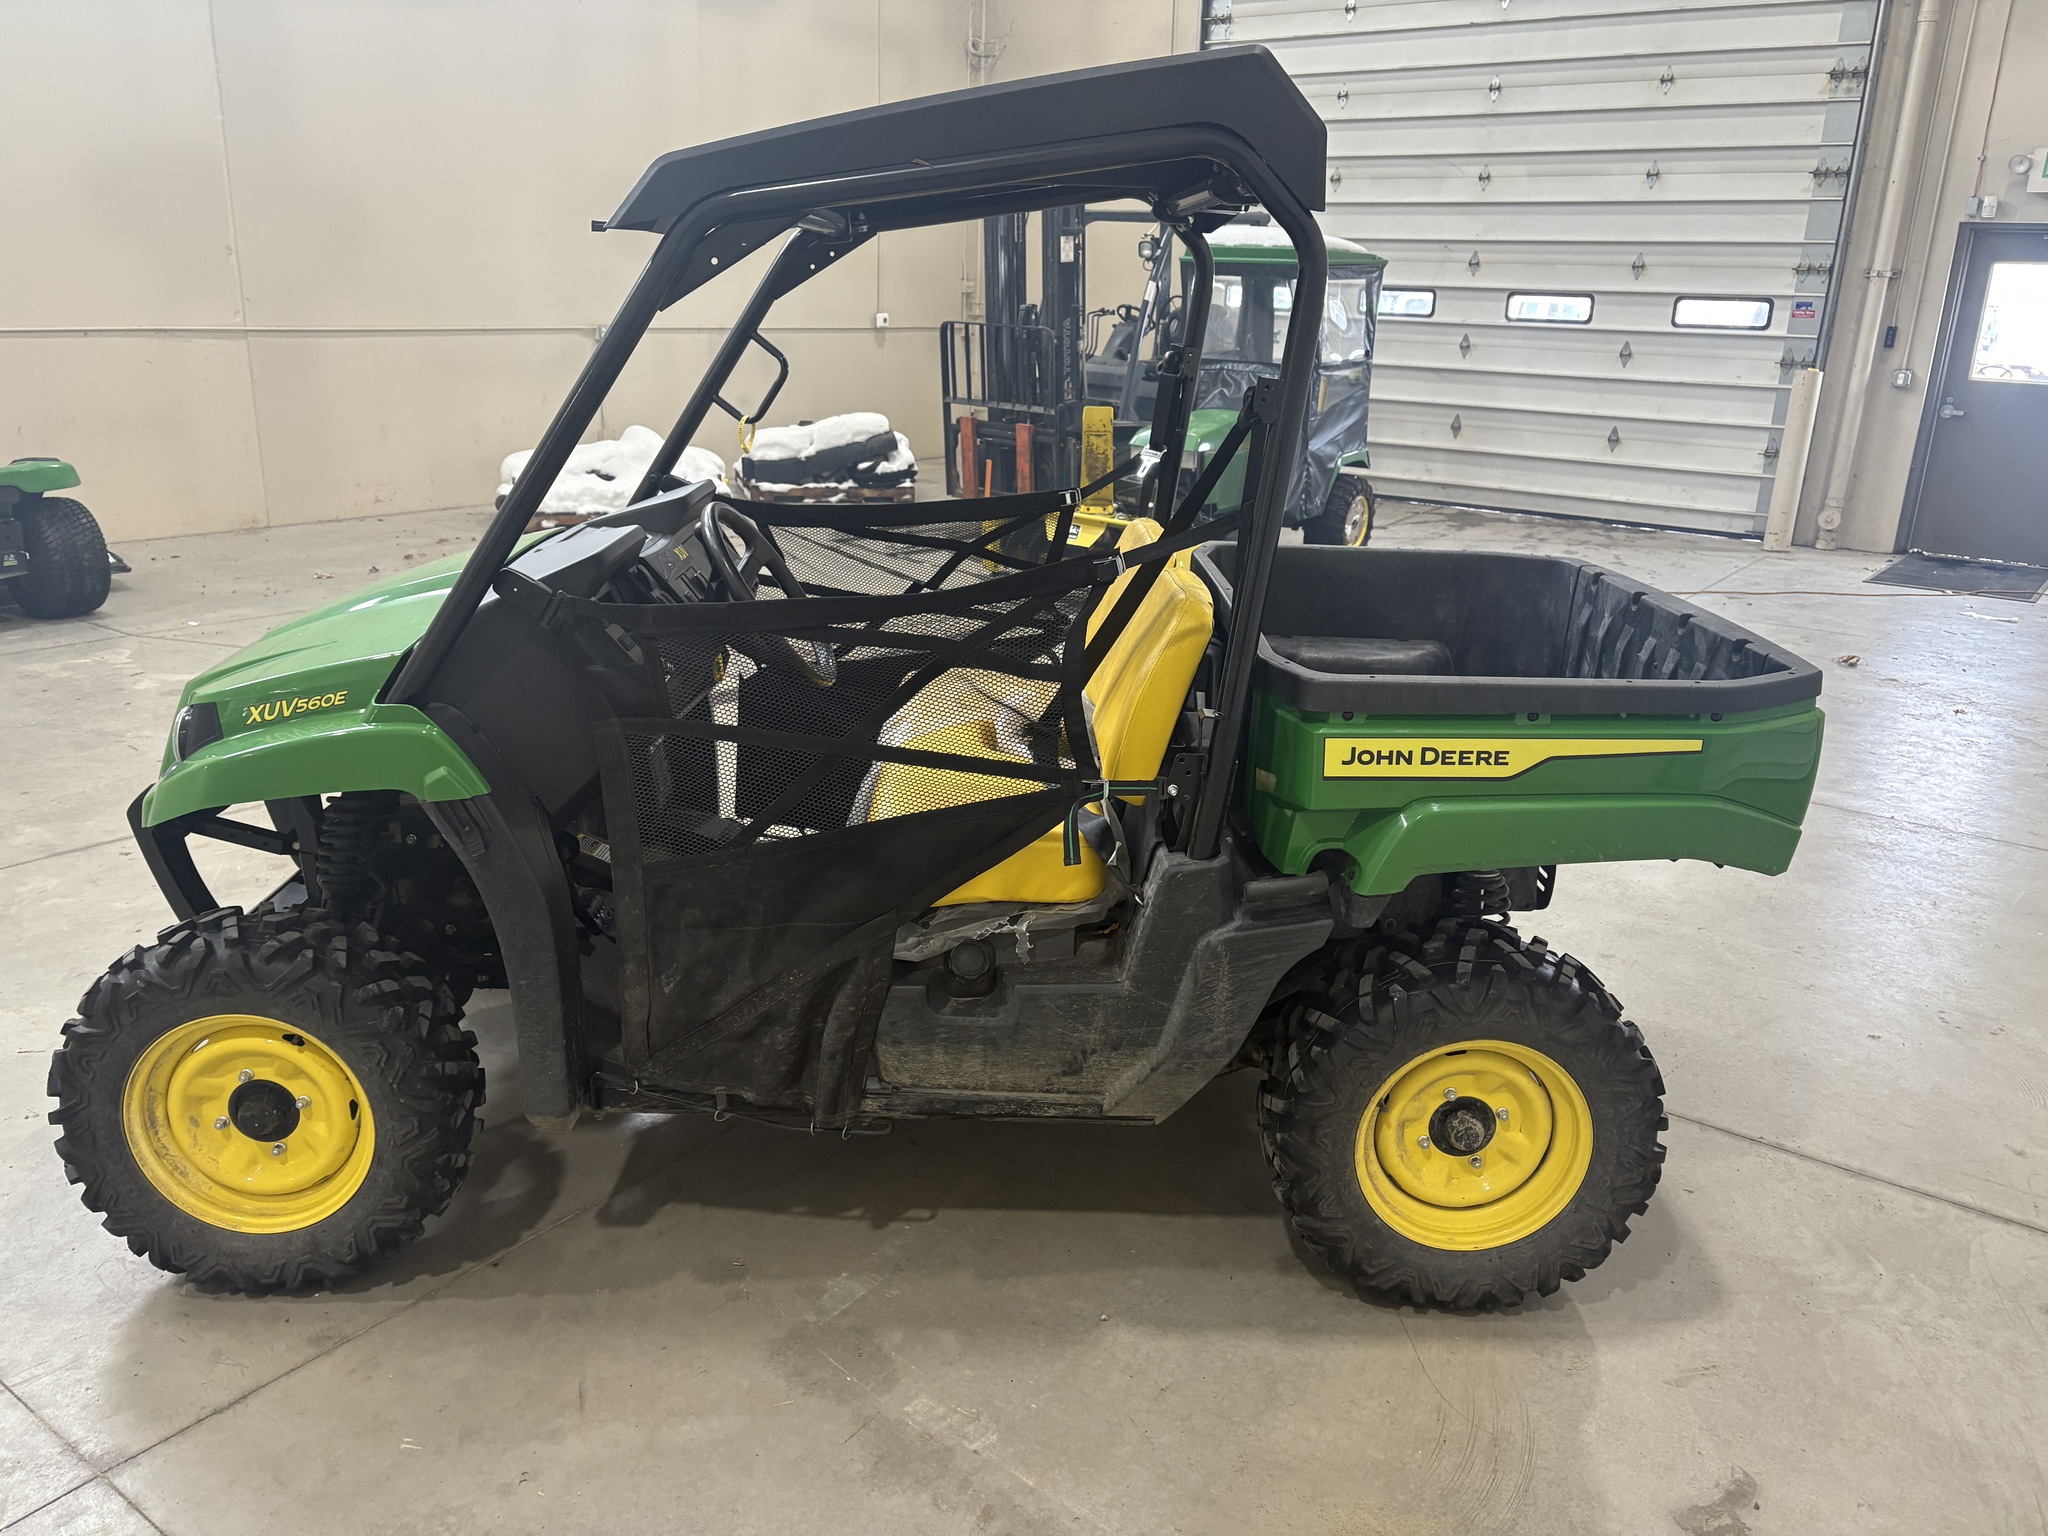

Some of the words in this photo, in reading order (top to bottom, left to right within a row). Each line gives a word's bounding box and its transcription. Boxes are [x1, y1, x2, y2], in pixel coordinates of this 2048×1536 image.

[1062, 317, 1072, 376] TOYOTA
[244, 690, 349, 726] XUV560E
[1341, 746, 1414, 766] JOHN
[1420, 746, 1510, 766] DEERE
